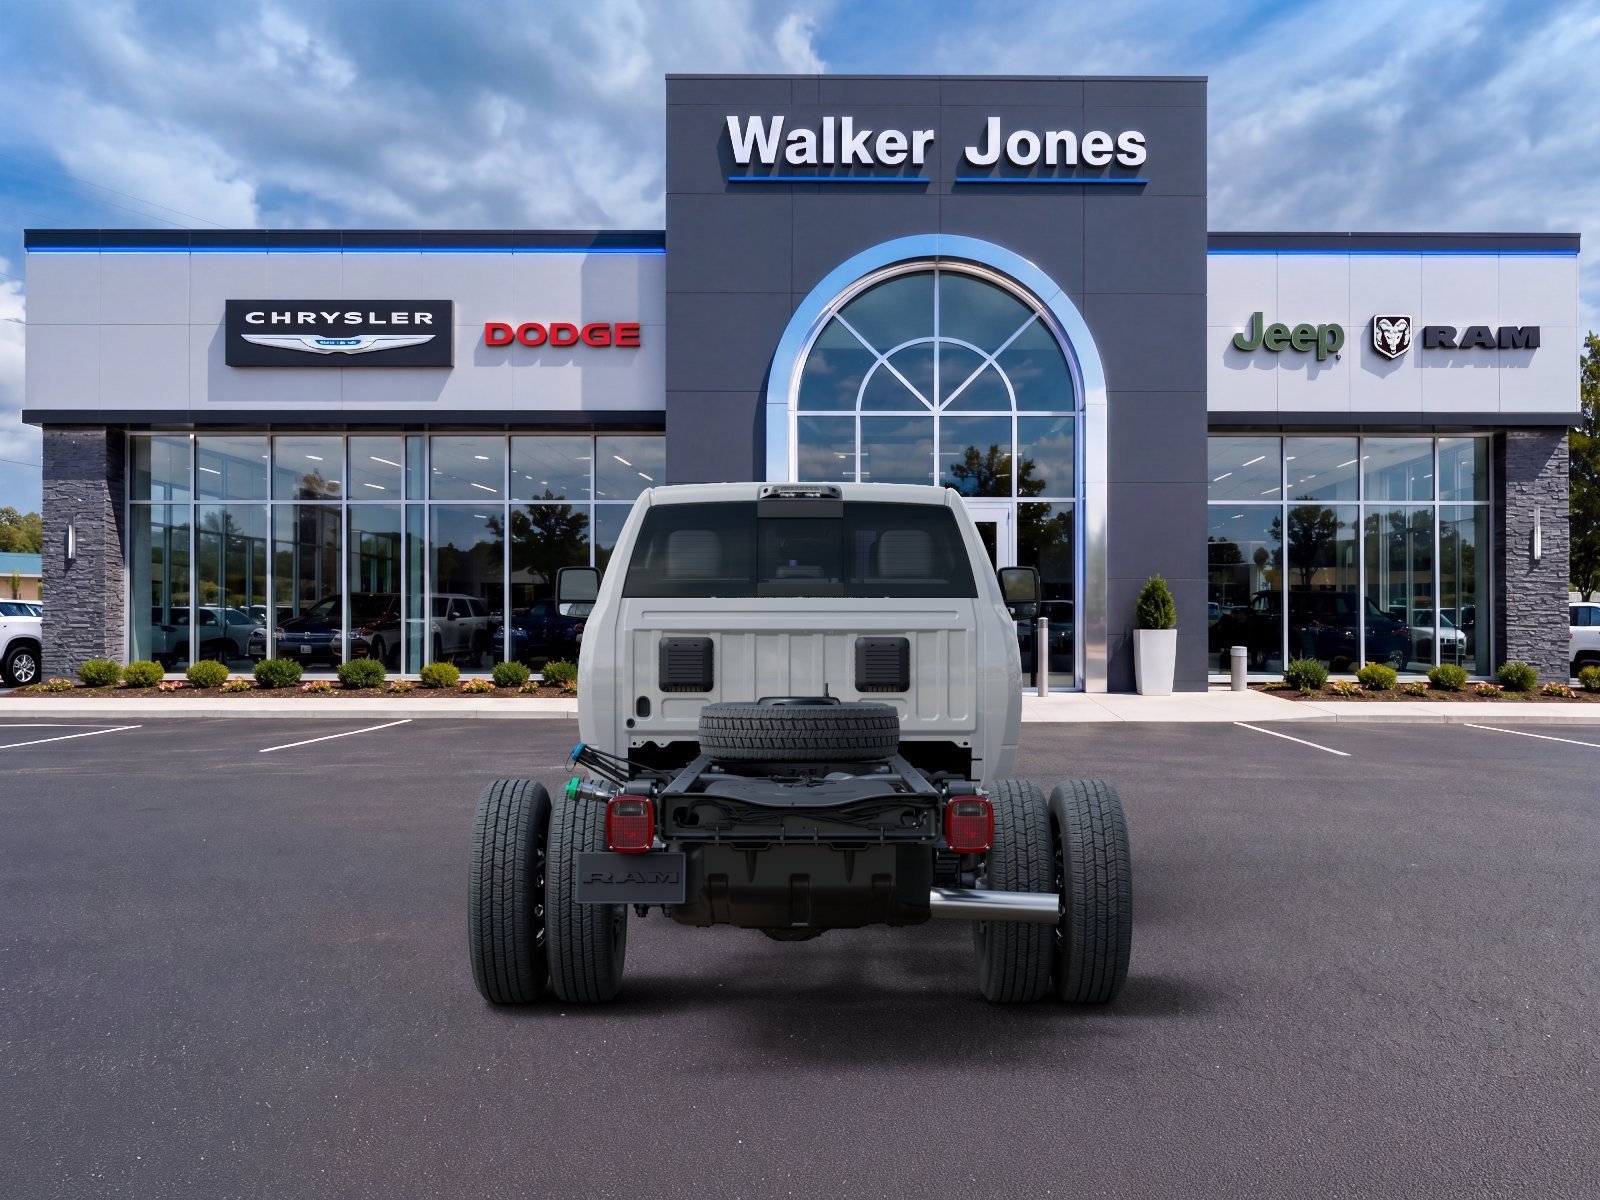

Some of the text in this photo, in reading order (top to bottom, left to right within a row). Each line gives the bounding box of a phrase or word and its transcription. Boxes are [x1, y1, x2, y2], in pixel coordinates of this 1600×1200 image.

[726, 115, 1147, 166] Walker Jones
[245, 311, 434, 325] CHRYSLER
[484, 322, 641, 347] DODGE
[1233, 311, 1345, 361] Jeep
[1424, 325, 1540, 348] RAM
[583, 871, 679, 884] RAM
